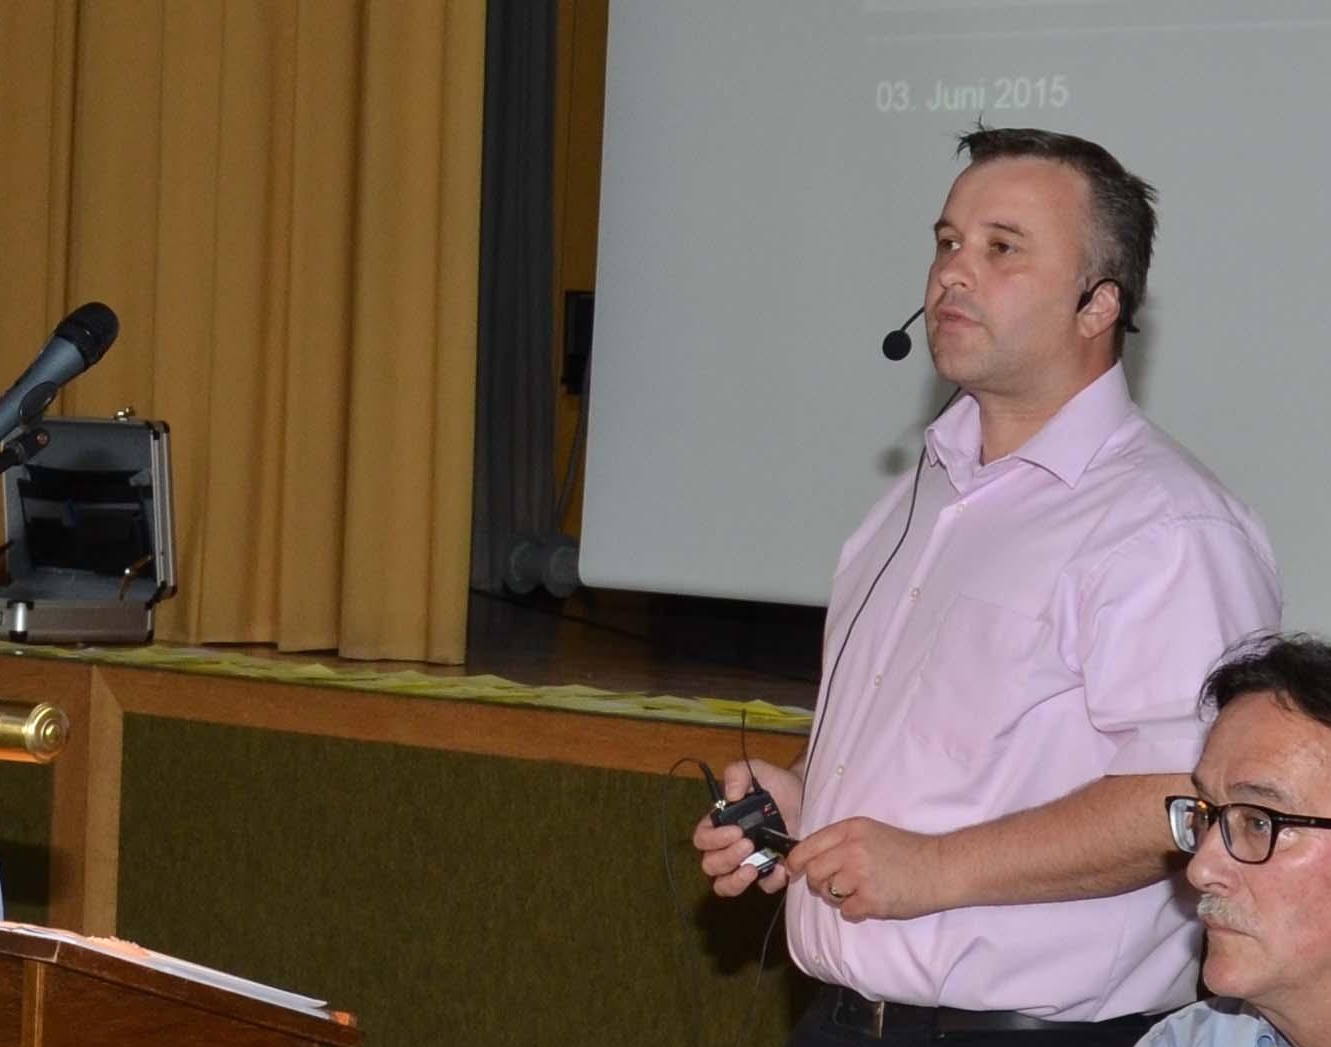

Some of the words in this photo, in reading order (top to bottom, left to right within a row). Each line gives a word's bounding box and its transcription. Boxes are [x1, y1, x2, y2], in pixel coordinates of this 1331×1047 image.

[874, 80, 919, 113] 03.
[925, 77, 988, 112] Juni
[994, 75, 1069, 110] 2015
